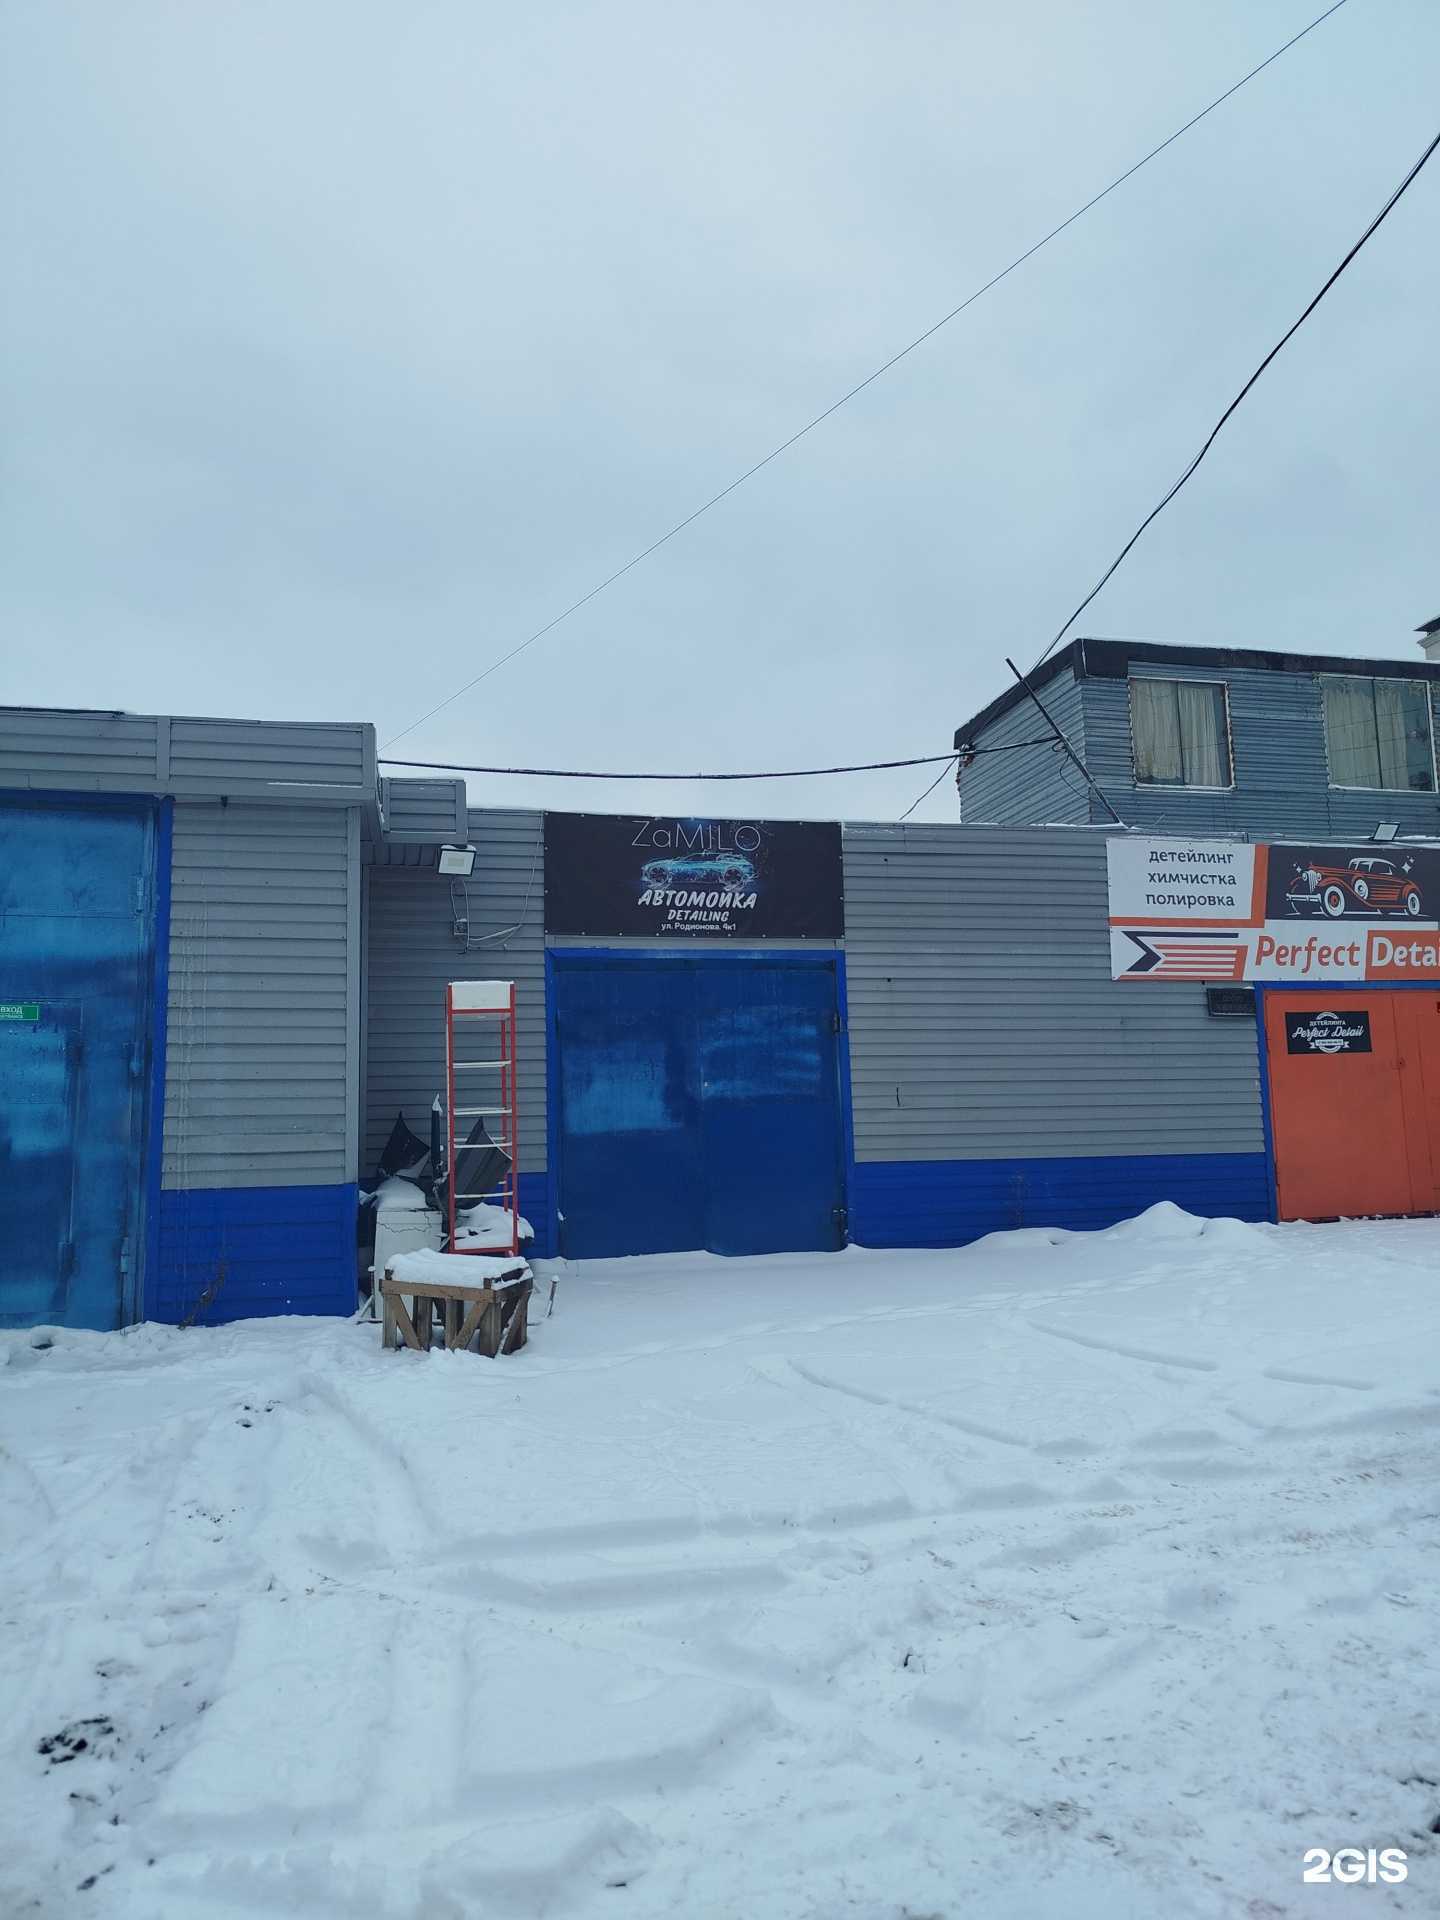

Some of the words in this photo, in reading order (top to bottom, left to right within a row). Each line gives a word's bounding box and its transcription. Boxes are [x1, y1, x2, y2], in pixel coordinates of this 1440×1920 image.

[632, 820, 761, 851] ZaMILO
[1149, 849, 1234, 865] детейлинг
[1148, 870, 1237, 885] химчистка
[1146, 892, 1235, 908] полировка
[667, 909, 729, 922] DETAILING
[661, 923, 673, 931] ул.
[1255, 934, 1361, 974] Perfect
[0, 1006, 23, 1014] ВХОД
[1292, 1027, 1330, 1041] Perfect
[1331, 1025, 1364, 1037] Detail
